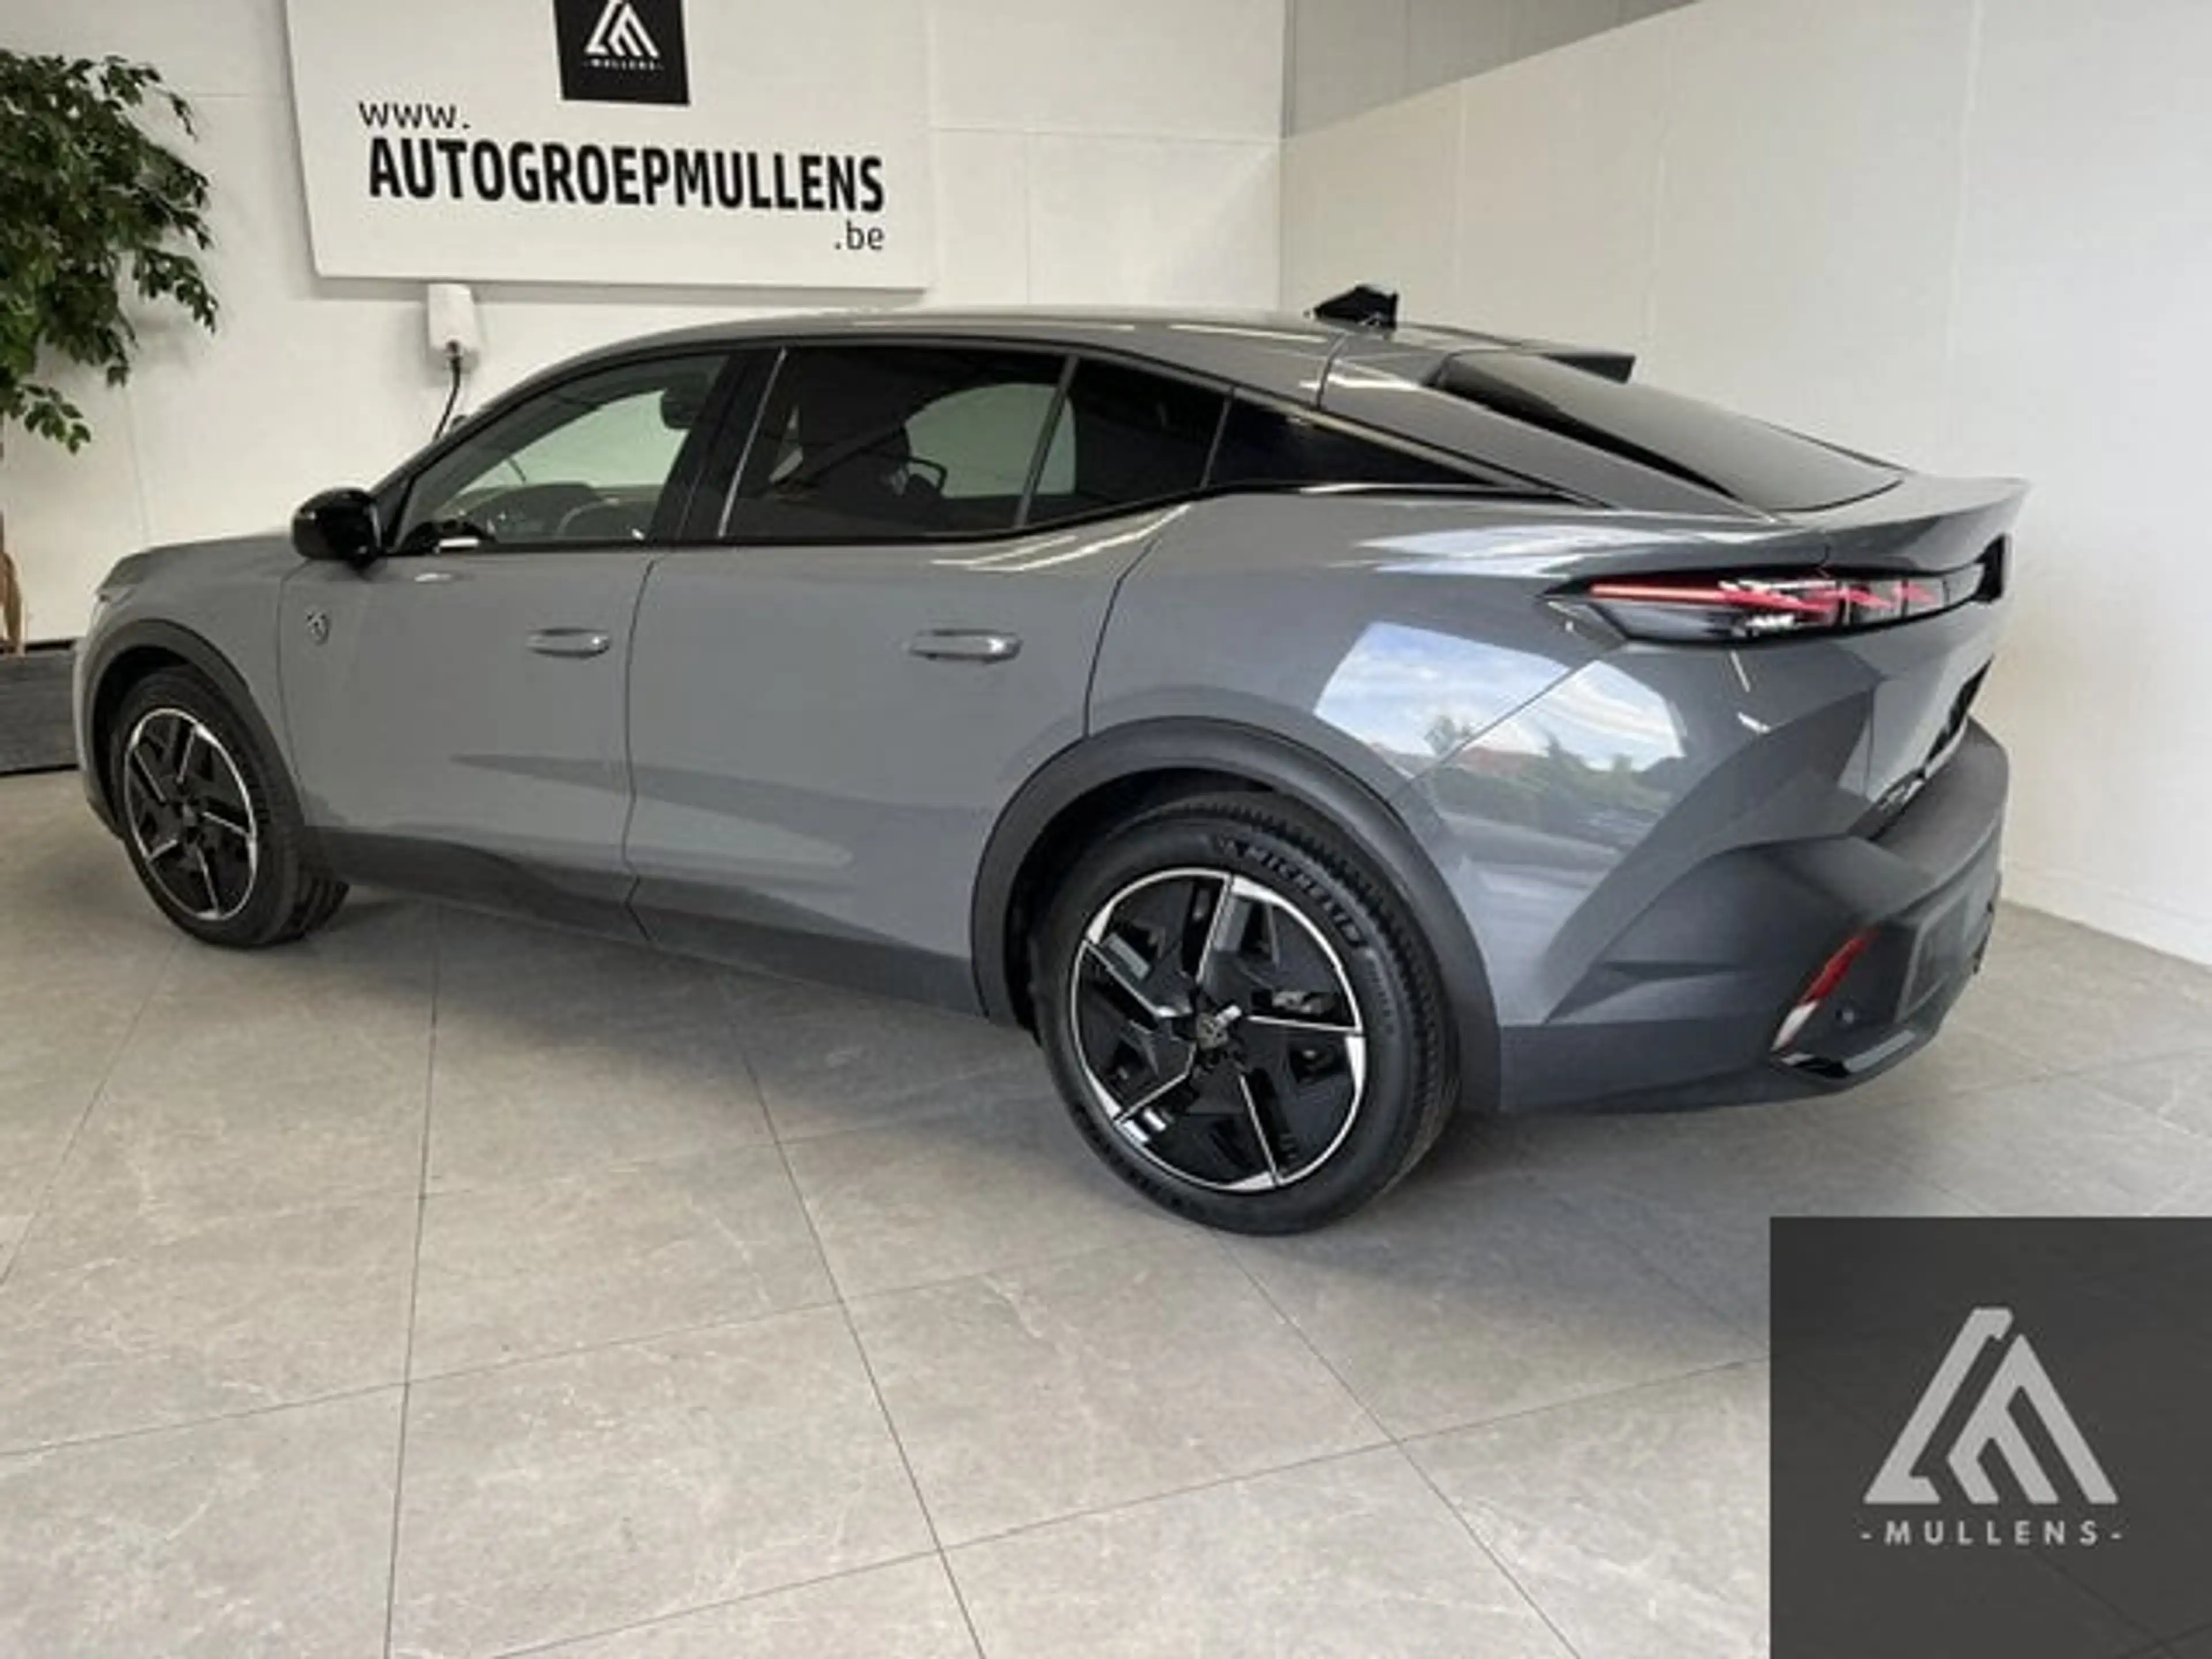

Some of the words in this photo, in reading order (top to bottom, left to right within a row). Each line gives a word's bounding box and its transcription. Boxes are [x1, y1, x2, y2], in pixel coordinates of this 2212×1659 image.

[358, 101, 471, 130] www.
[368, 136, 884, 213] AUTOGROEPMULLENS
[834, 219, 884, 251] .be
